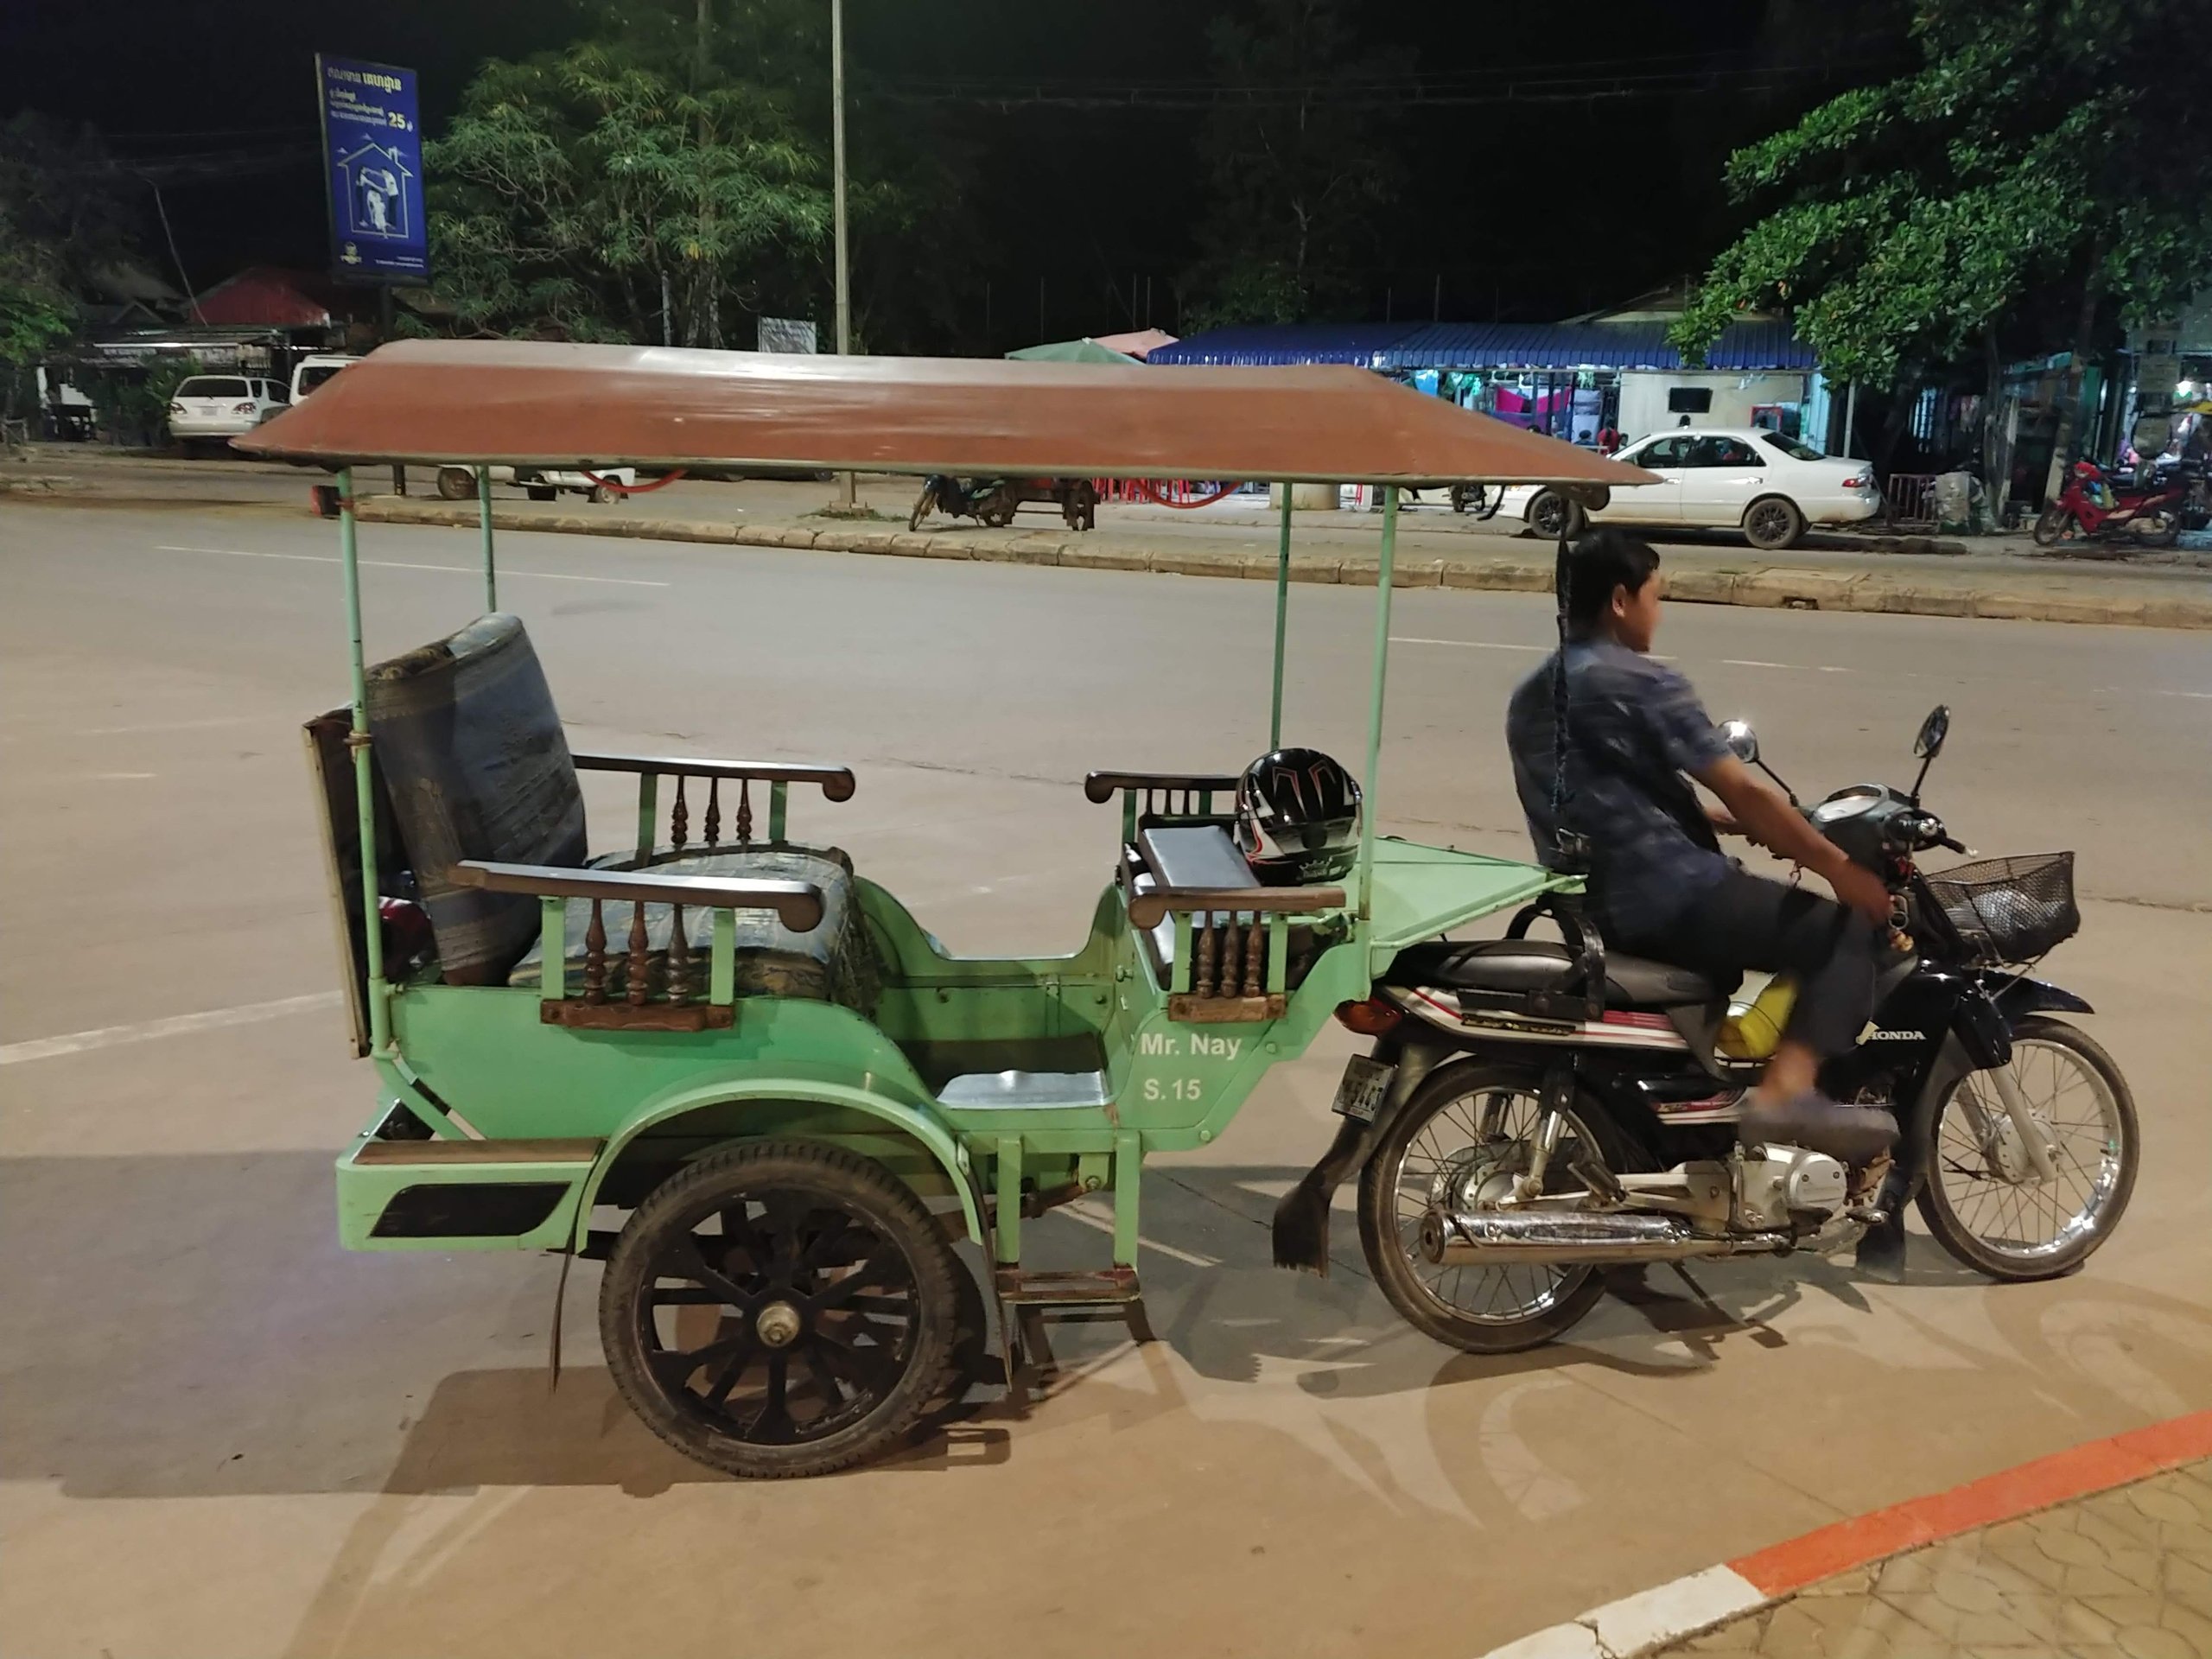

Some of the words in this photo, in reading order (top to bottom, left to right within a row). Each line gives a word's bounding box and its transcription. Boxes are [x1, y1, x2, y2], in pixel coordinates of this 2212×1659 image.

[388, 111, 406, 130] 25
[1141, 1033, 1179, 1055] Mr.
[1191, 1033, 1242, 1061] Nay
